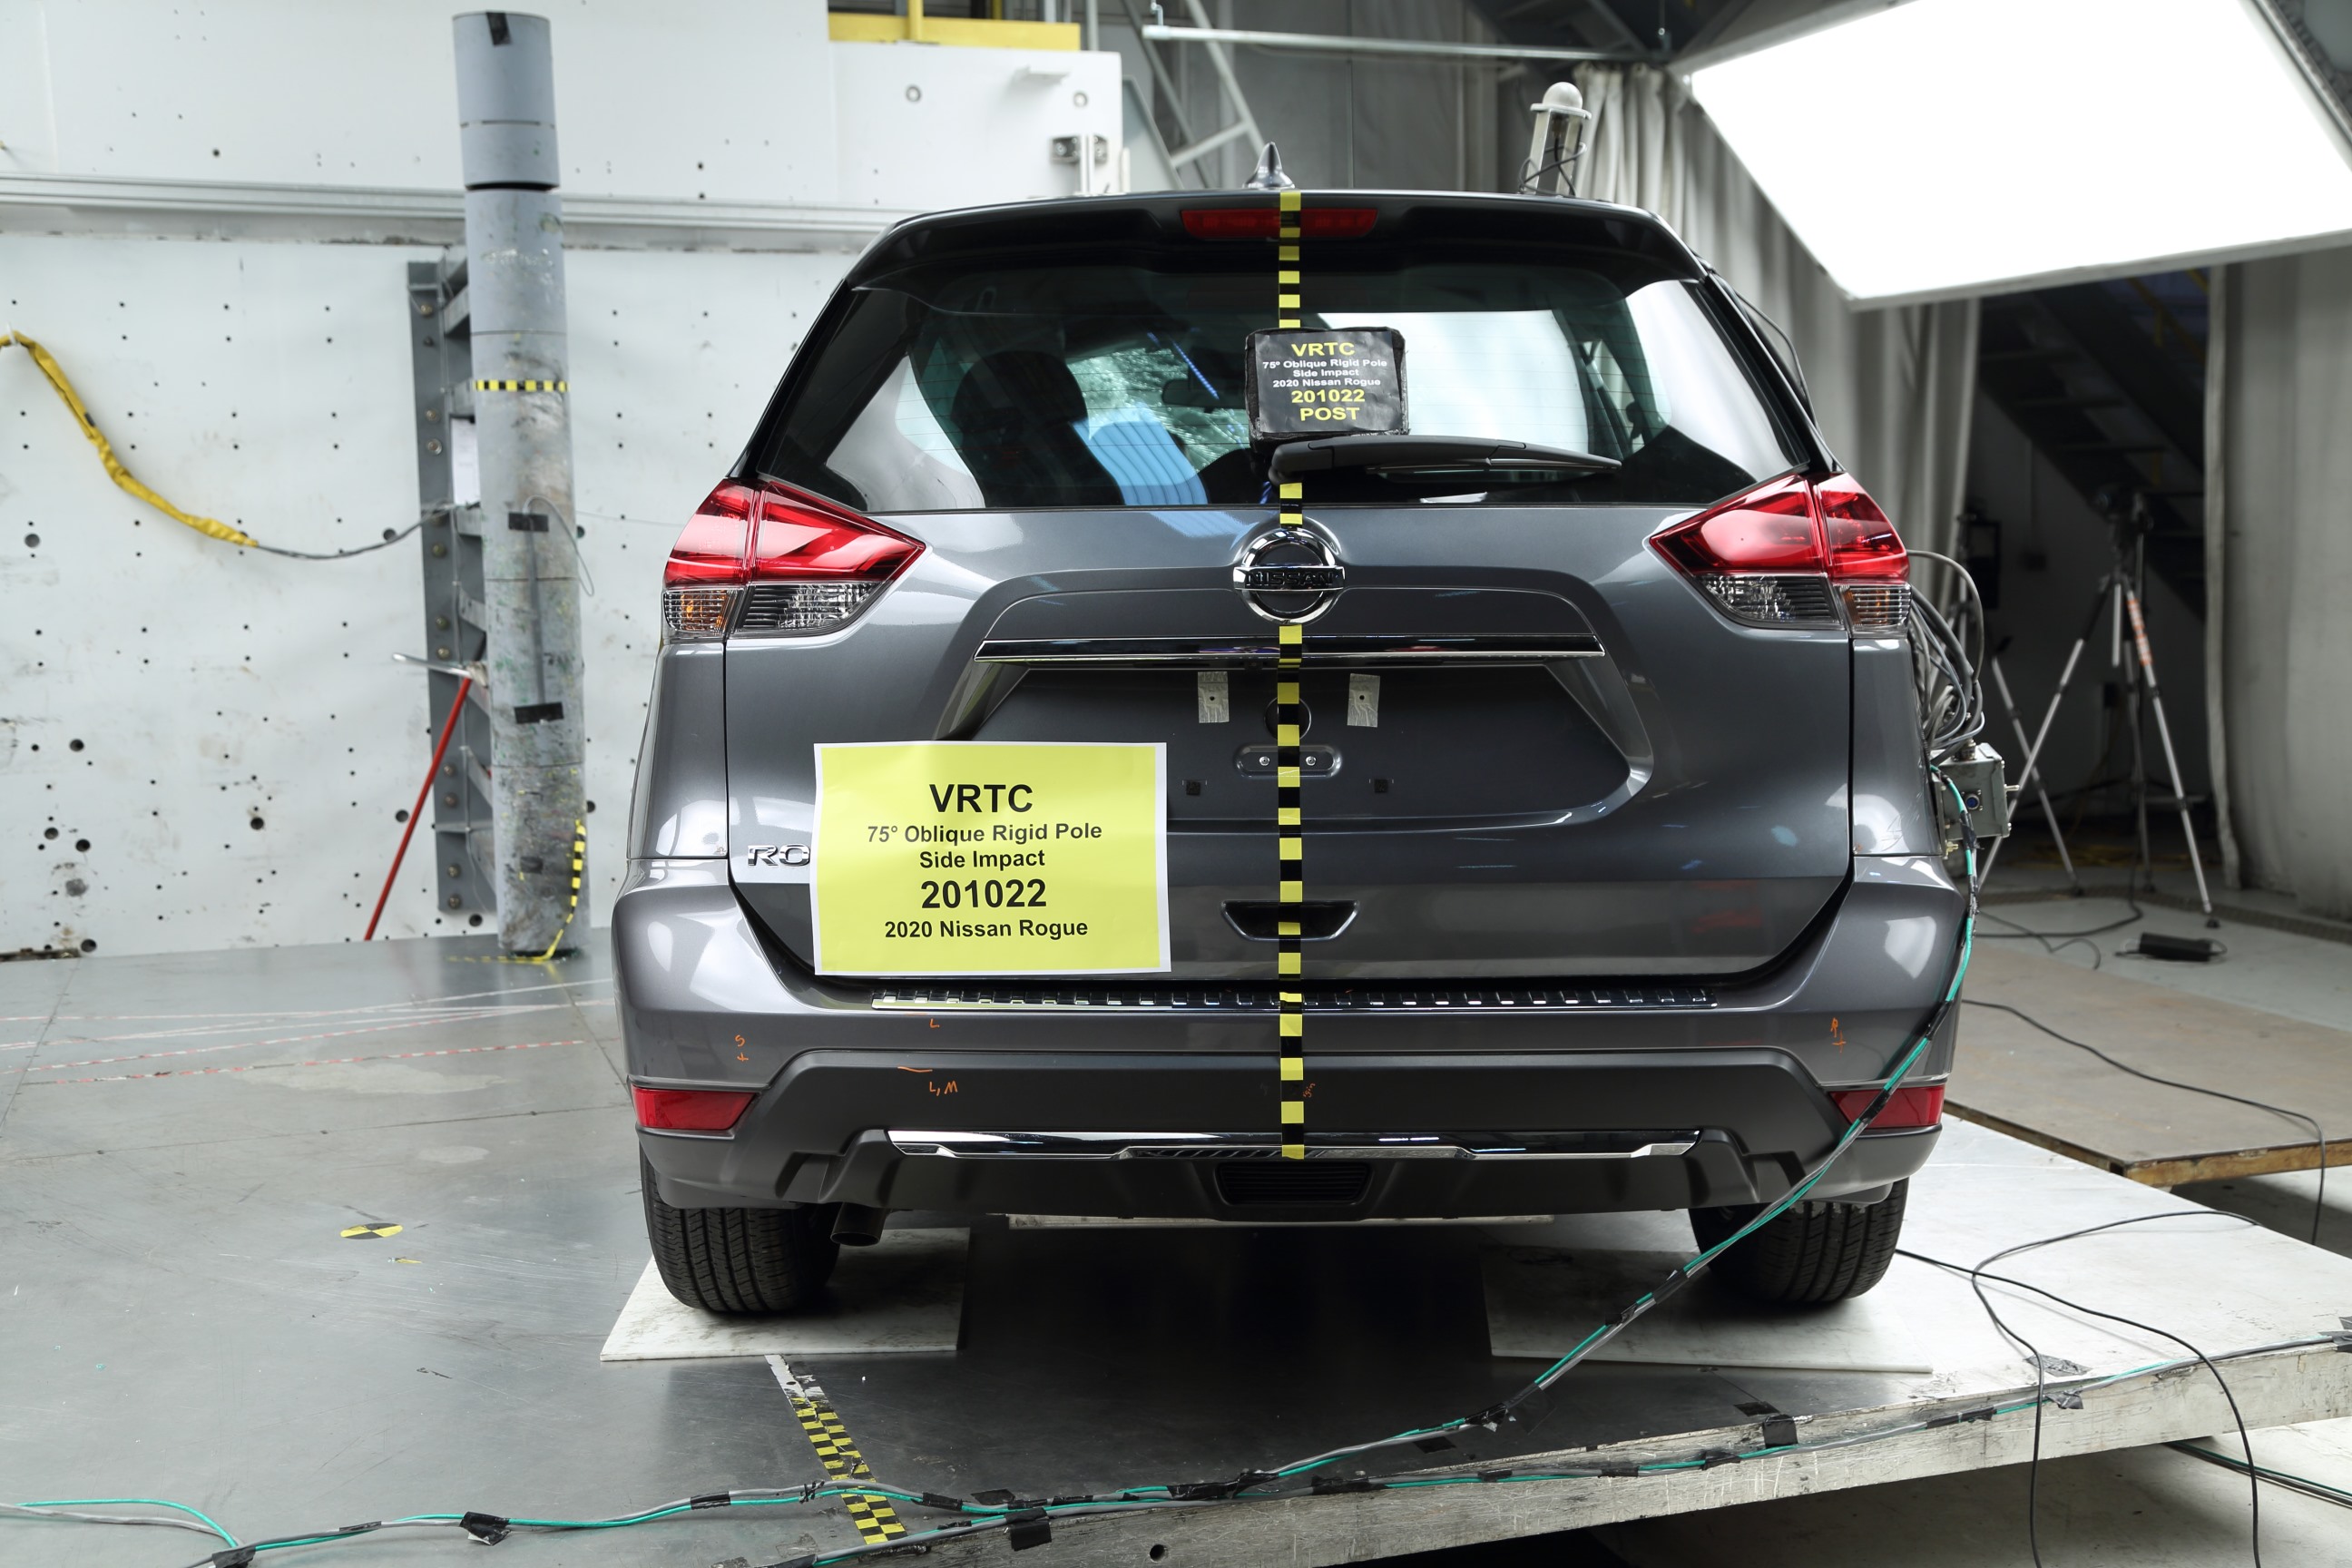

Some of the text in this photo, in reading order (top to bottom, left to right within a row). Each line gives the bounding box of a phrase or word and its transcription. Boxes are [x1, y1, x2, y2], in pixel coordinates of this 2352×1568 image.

[1291, 342, 1356, 357] VRTC
[1283, 360, 1328, 369] Oblique
[1330, 359, 1359, 368] Rigid
[1363, 358, 1387, 368] Pole
[1293, 369, 1359, 377] Side Impact
[1272, 378, 1381, 387] 2020 Nissan Rogue
[1291, 389, 1366, 404] 201022
[1299, 407, 1360, 421] POST
[1246, 571, 1334, 587] NISSAN
[929, 784, 1034, 813] VRTC
[905, 825, 985, 847] Oblique
[993, 823, 1048, 845] Rigid
[1055, 822, 1102, 839] Pole
[919, 849, 1045, 872] Side Impact
[921, 879, 1047, 908] 201022
[885, 919, 1088, 940] 2020 Nissan Rogue
